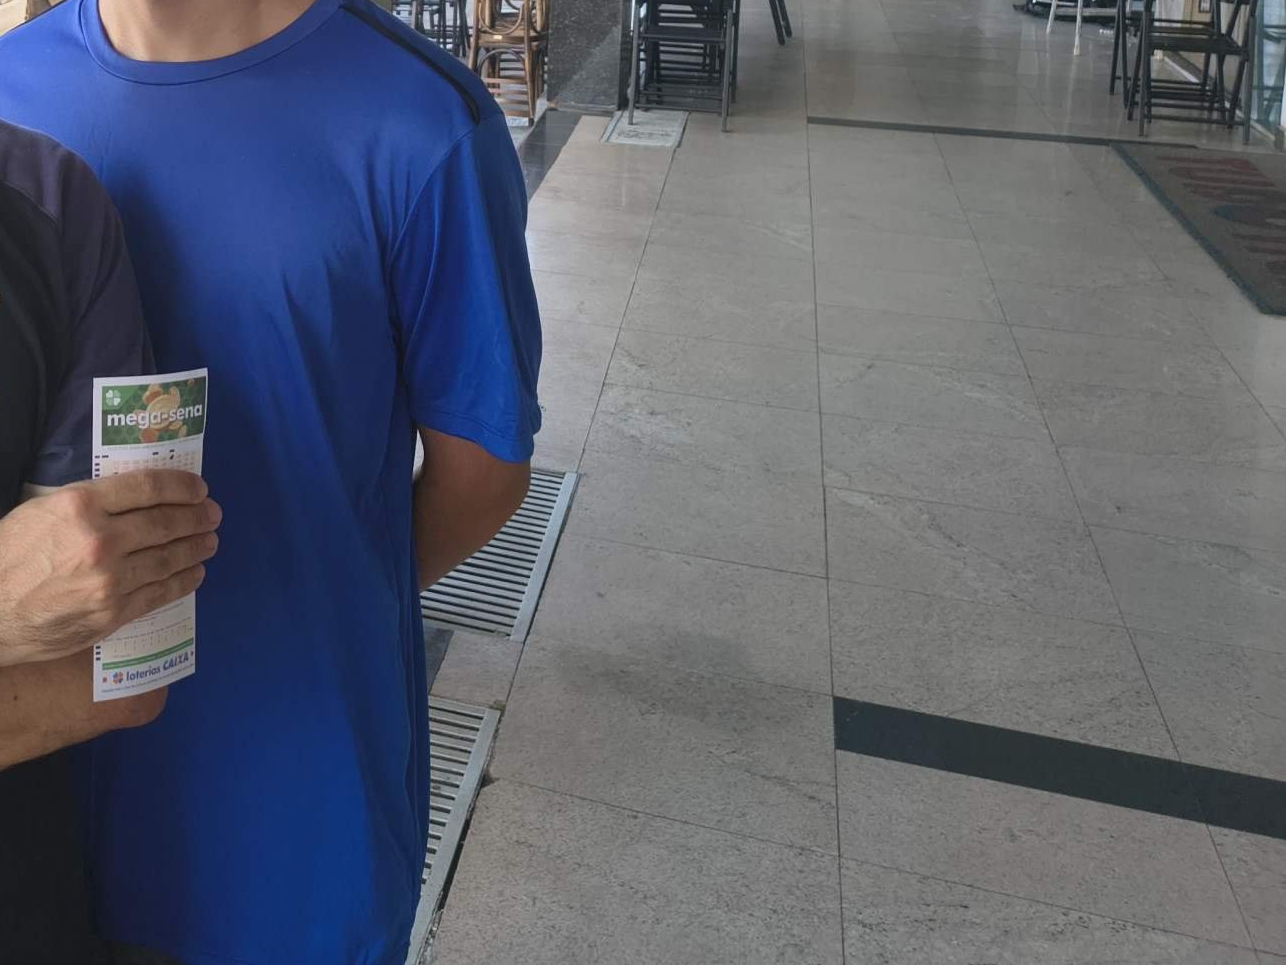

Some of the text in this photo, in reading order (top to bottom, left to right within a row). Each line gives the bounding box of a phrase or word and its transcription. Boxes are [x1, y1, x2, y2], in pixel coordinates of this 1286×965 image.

[107, 403, 203, 429] mega-sena
[126, 651, 189, 681] loterias CAIXA
